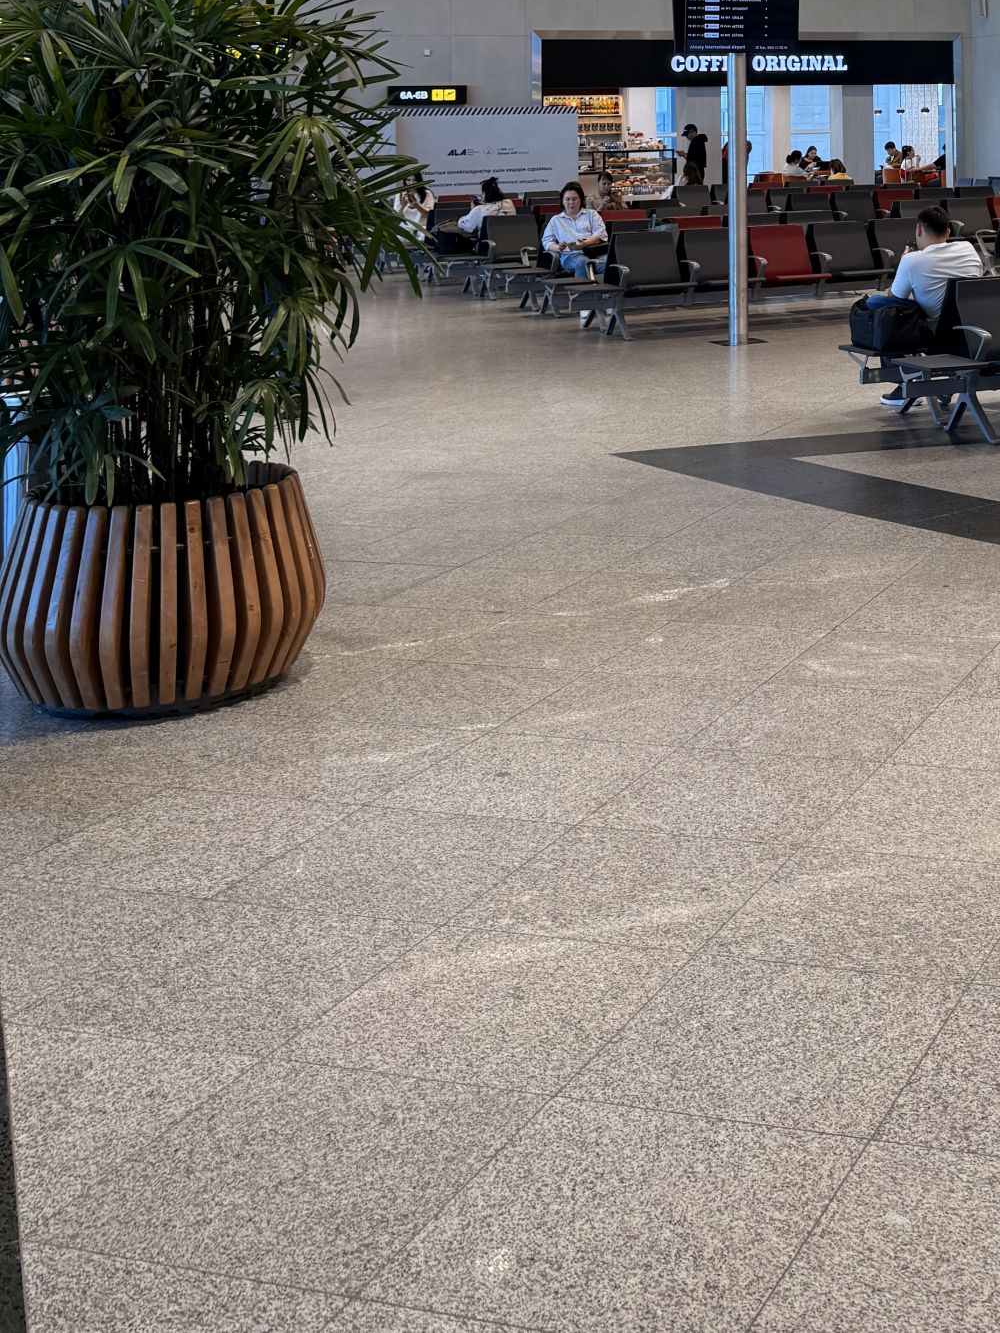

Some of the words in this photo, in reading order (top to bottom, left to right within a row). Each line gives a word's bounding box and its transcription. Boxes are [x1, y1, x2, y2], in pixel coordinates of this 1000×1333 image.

[671, 55, 728, 72] COFF
[752, 55, 848, 72] ORIGINAL
[399, 90, 429, 100] 6A-6B
[447, 148, 467, 157] ALA
